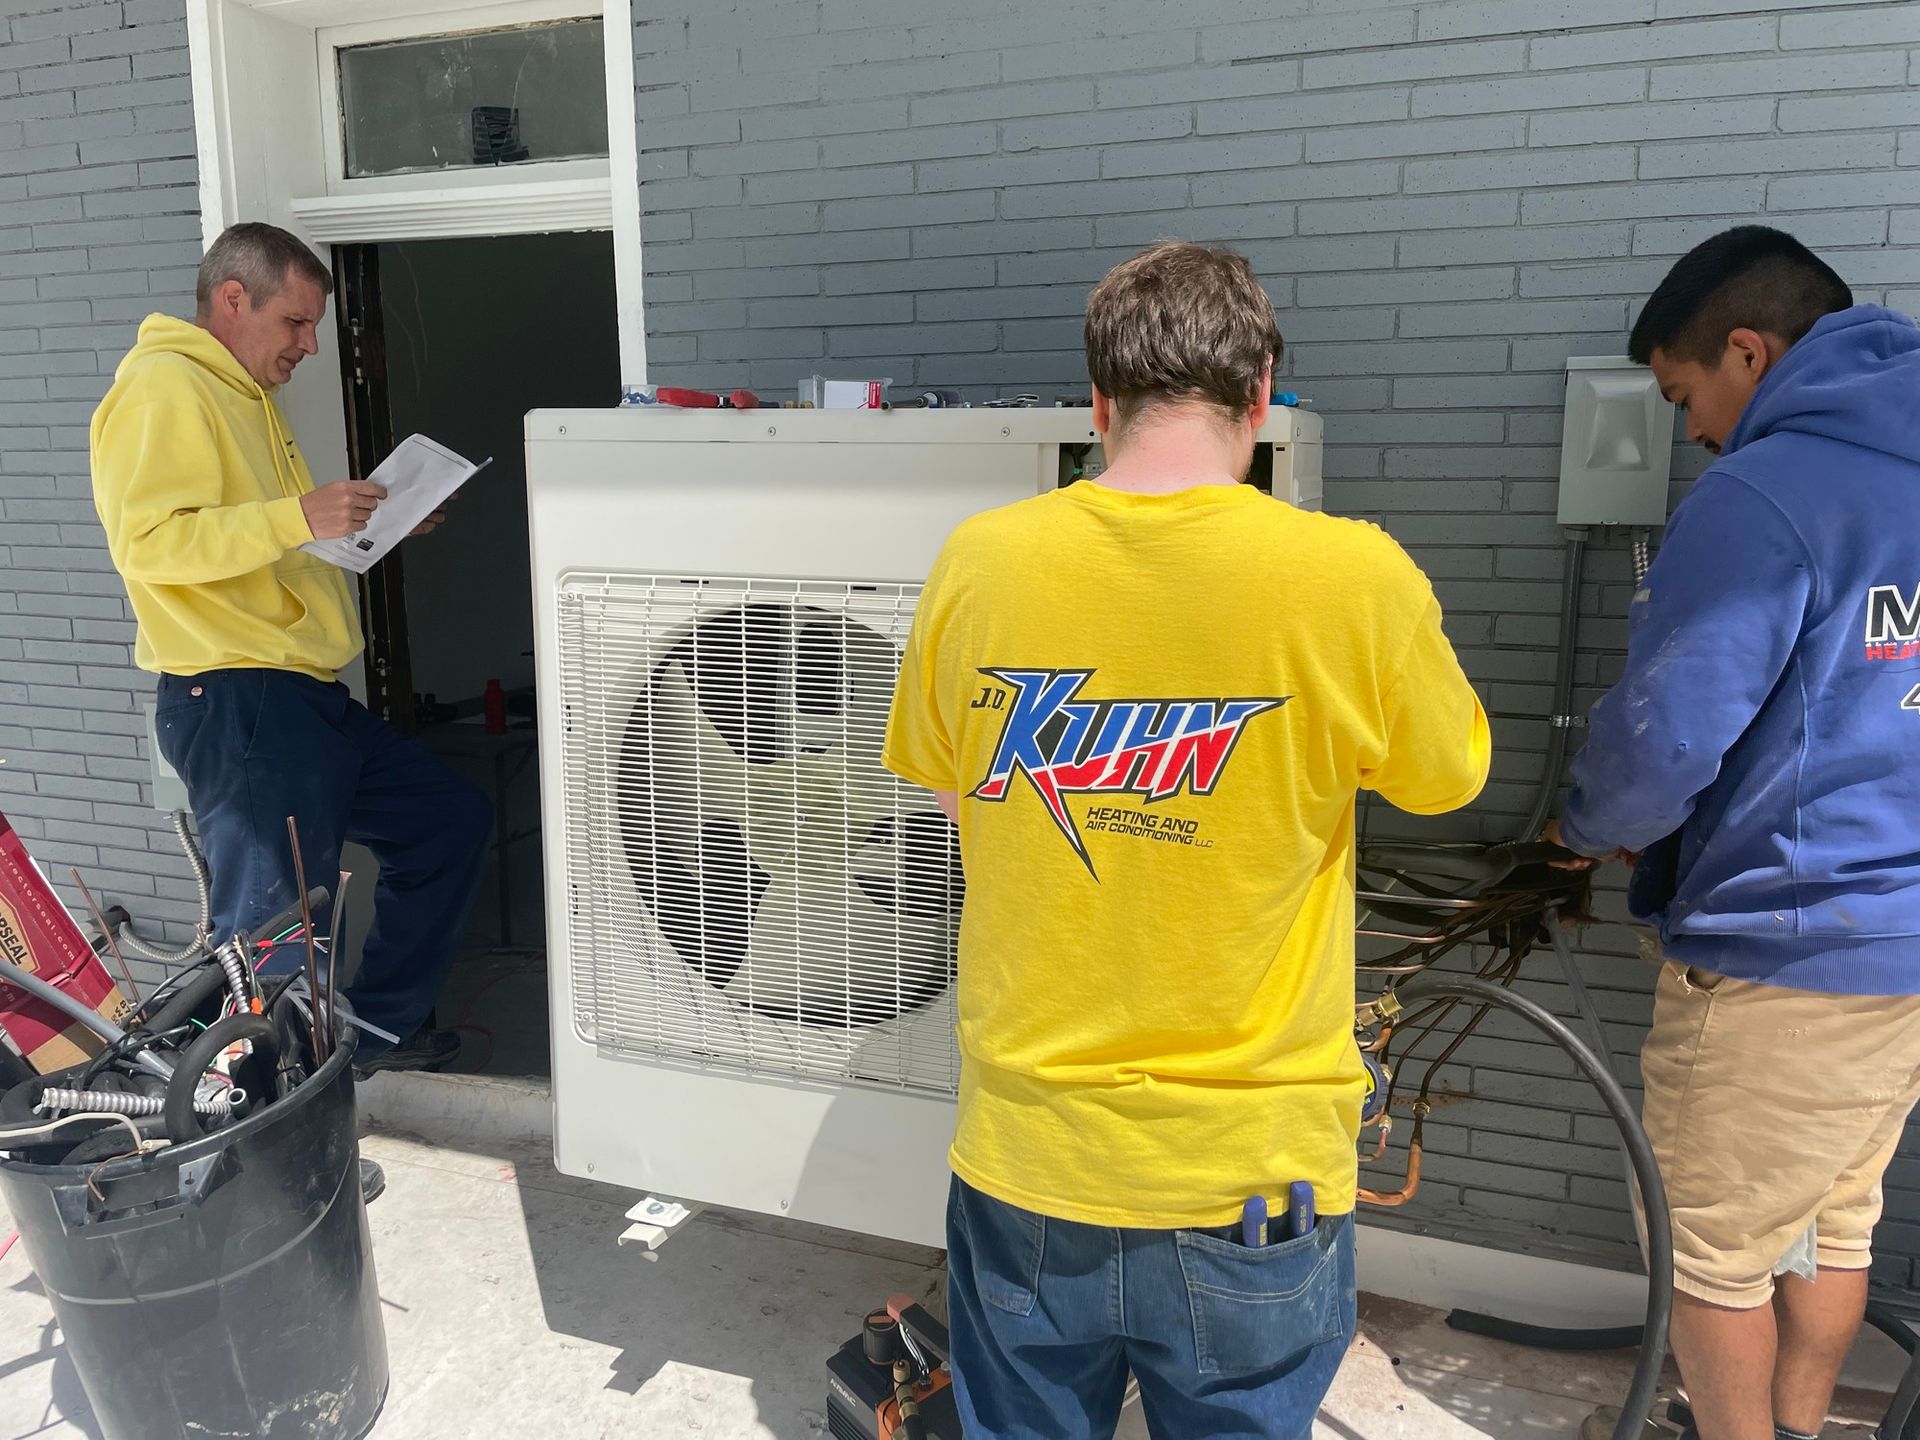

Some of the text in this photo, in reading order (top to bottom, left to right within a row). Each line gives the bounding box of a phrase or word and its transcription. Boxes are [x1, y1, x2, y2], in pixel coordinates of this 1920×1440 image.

[965, 667, 1295, 885] J.D. KUHN
[1085, 820, 1214, 848] AIR CONDITIONING LLC
[1086, 807, 1199, 834] HEATING AND
